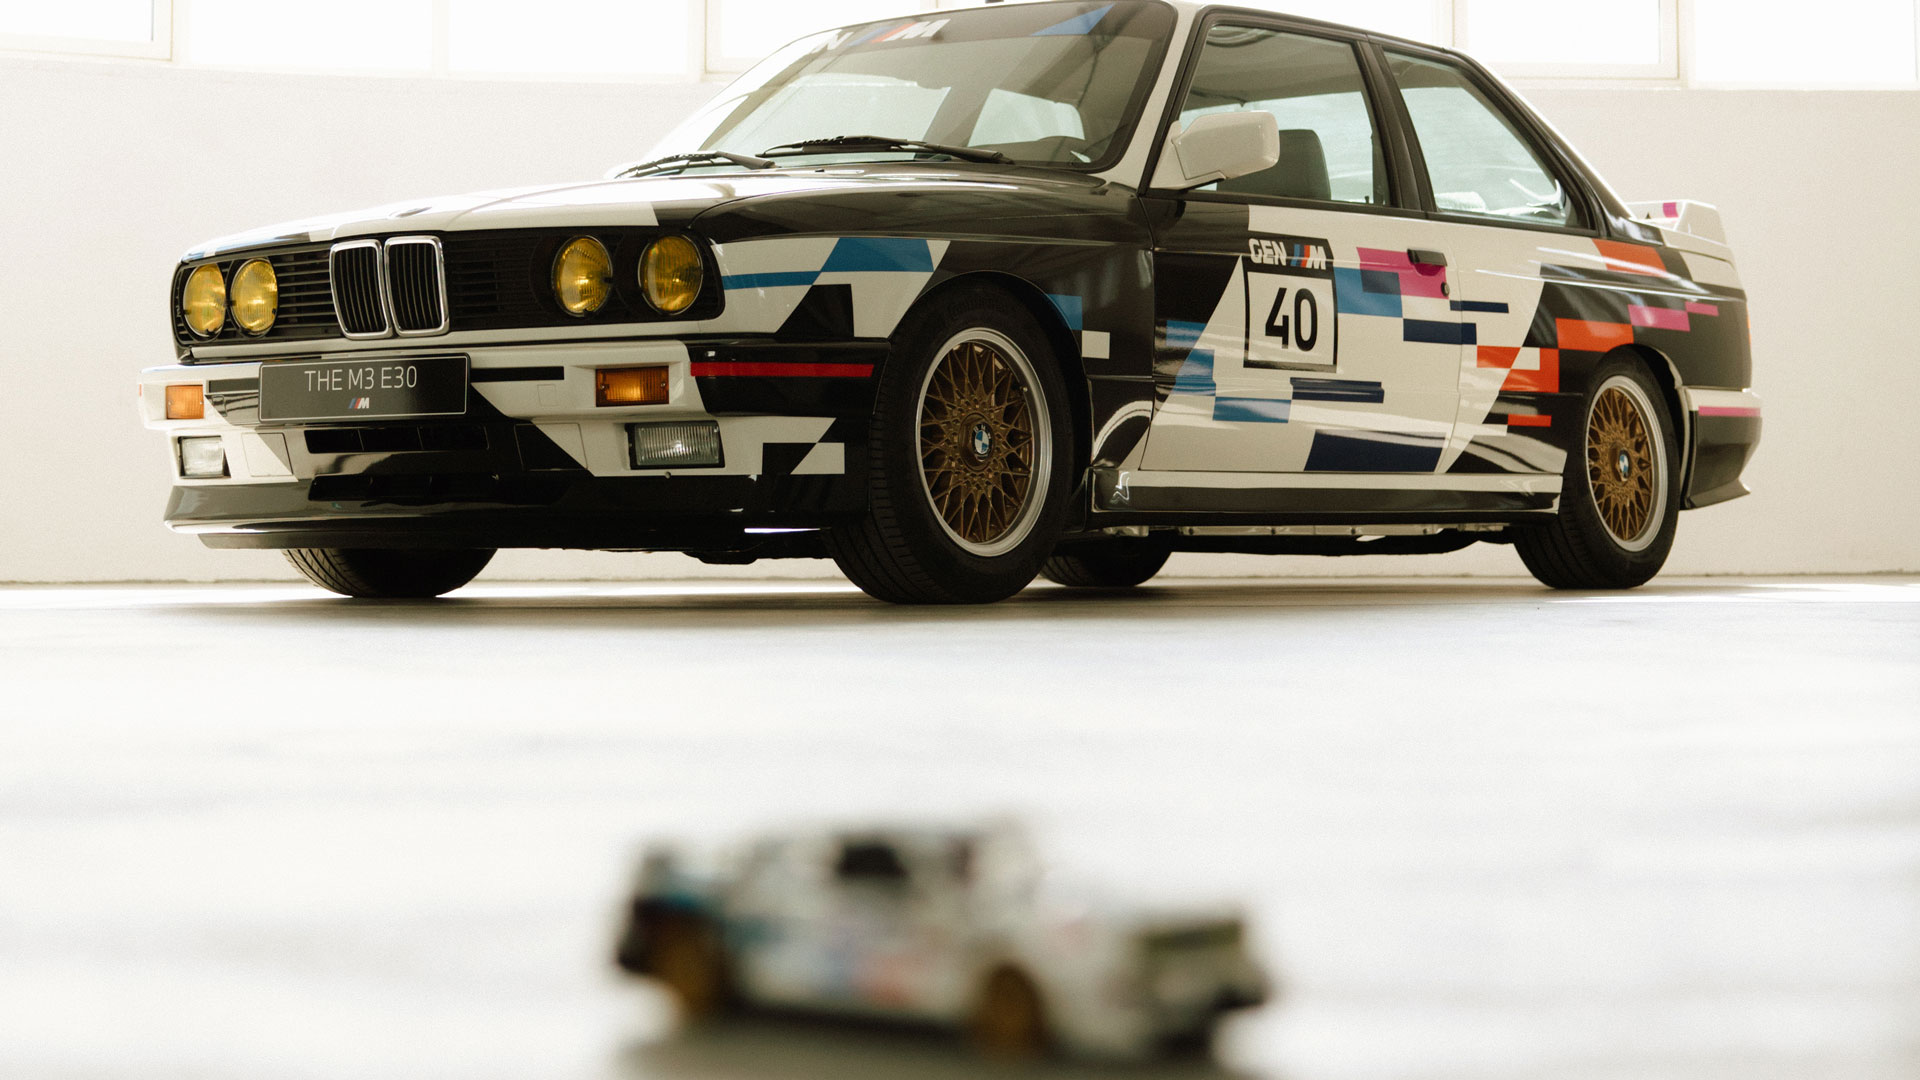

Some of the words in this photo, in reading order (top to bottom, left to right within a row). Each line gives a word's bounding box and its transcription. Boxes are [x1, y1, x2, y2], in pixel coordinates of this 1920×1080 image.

[1248, 238, 1287, 266] GEN
[1265, 287, 1318, 352] 40
[304, 368, 343, 392] THE
[348, 367, 375, 390] M3
[381, 365, 418, 388] E30
